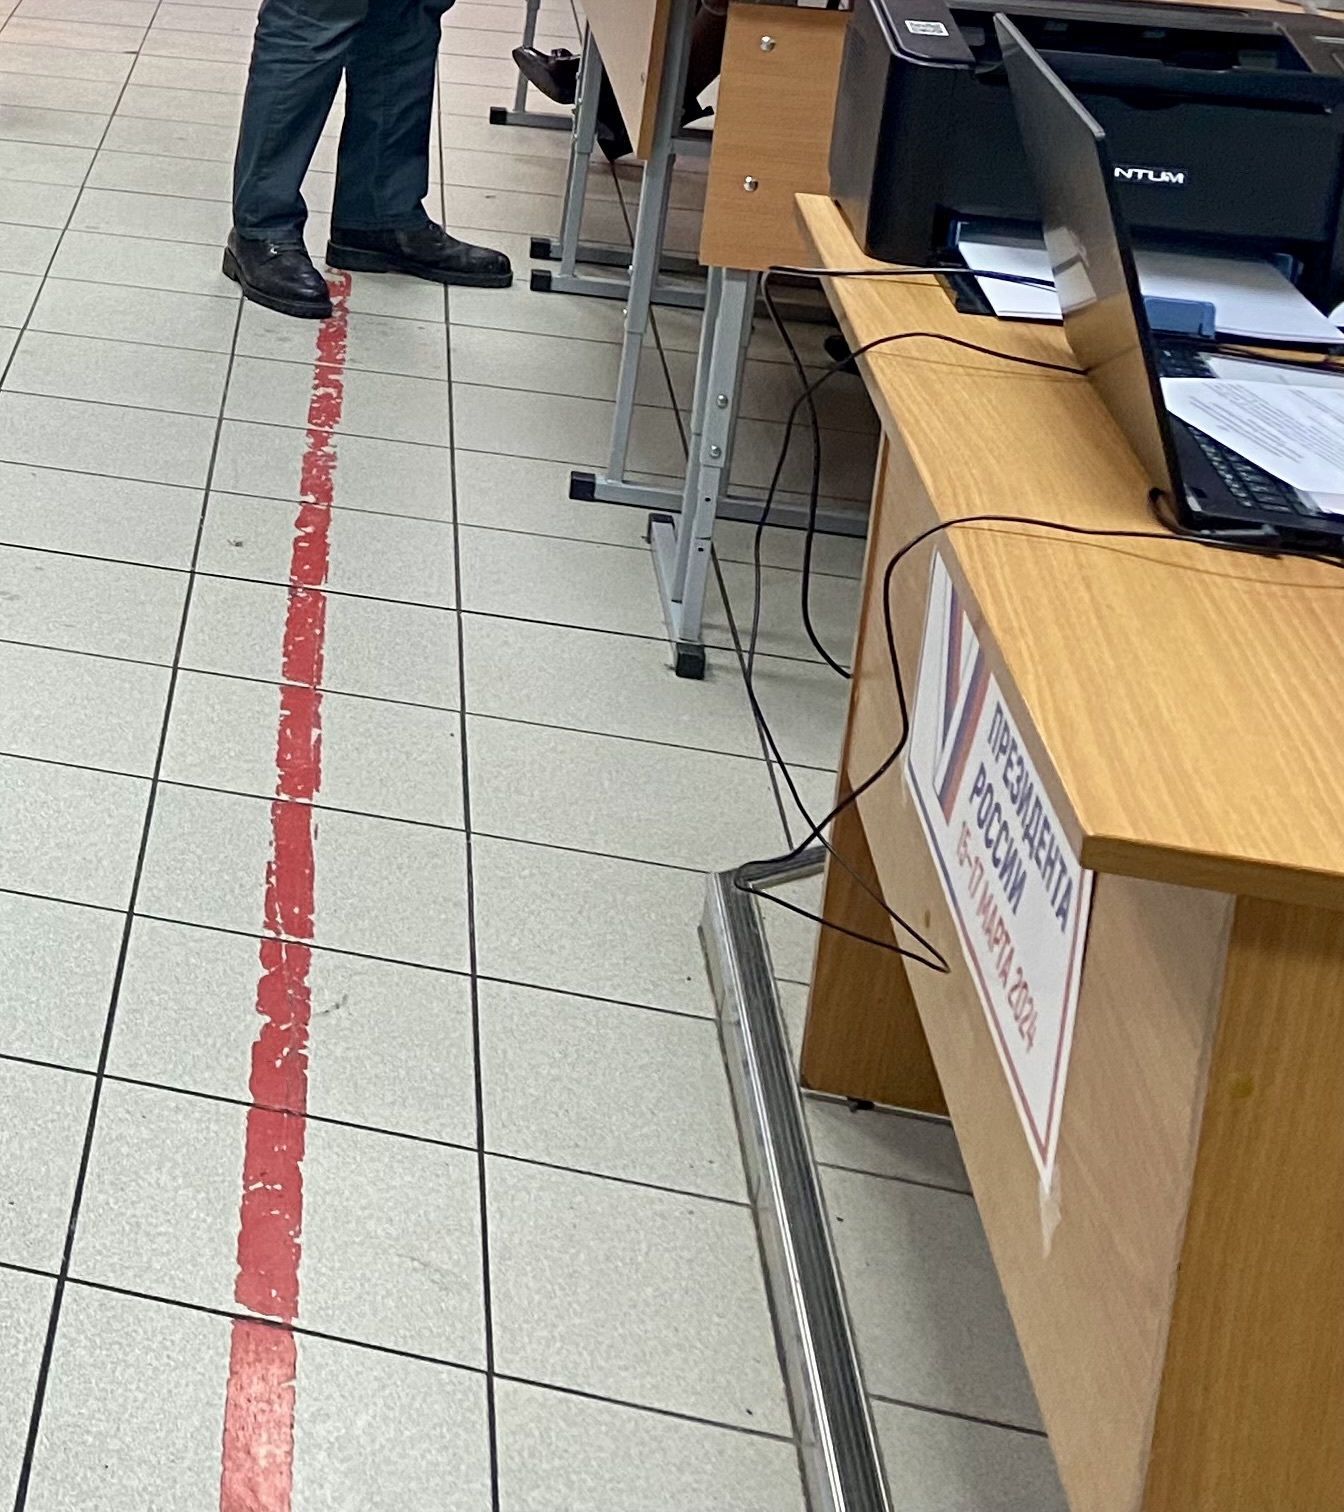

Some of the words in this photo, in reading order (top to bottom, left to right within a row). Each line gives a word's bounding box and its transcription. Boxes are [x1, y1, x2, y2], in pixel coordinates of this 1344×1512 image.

[1113, 166, 1186, 185] NTUM
[969, 761, 1028, 916] РОССИИ
[986, 700, 1073, 934] ПРЕЗИДЕНТА
[975, 881, 1016, 989] МАРТА
[1006, 965, 1039, 1054] 2024
